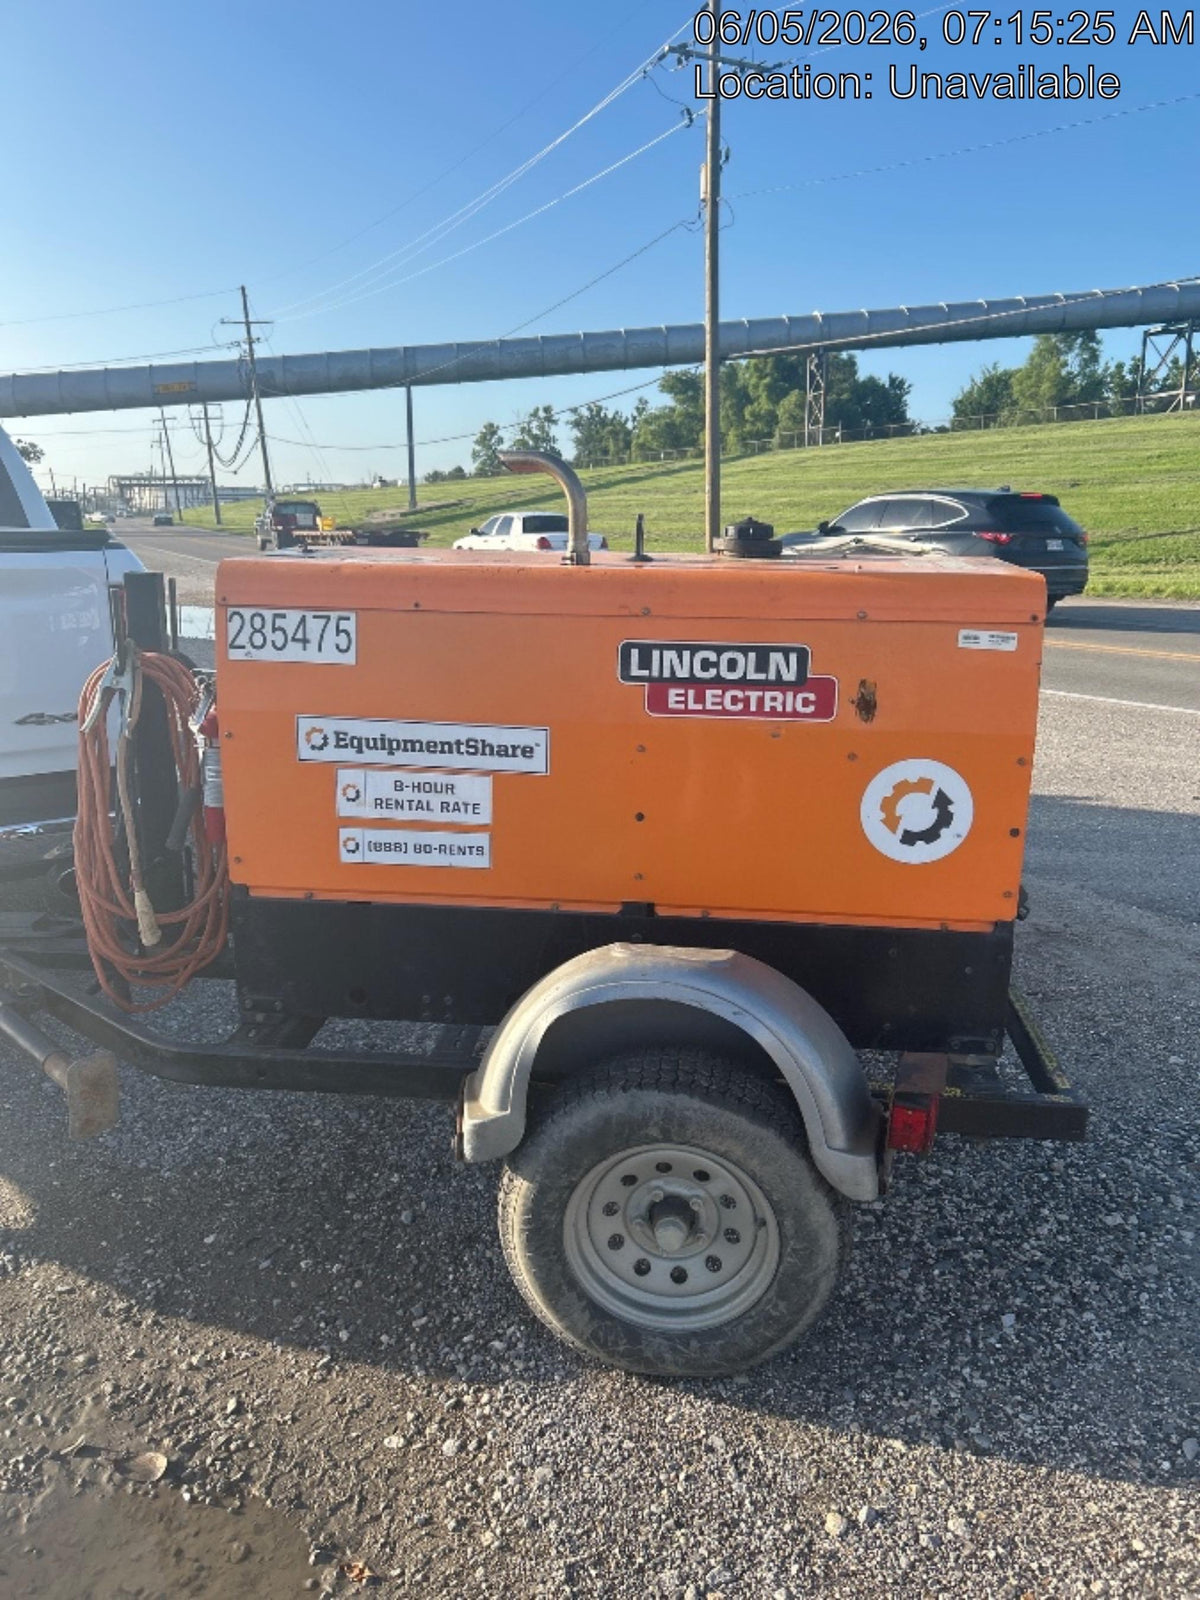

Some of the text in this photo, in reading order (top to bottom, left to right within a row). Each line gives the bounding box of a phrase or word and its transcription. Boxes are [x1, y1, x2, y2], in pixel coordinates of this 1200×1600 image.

[228, 611, 353, 653] 285475
[630, 648, 798, 682] LINCOLN
[668, 688, 817, 714] ELECTRIC
[333, 731, 535, 759] EquipmentShare
[374, 798, 481, 815] RENTAL RATE
